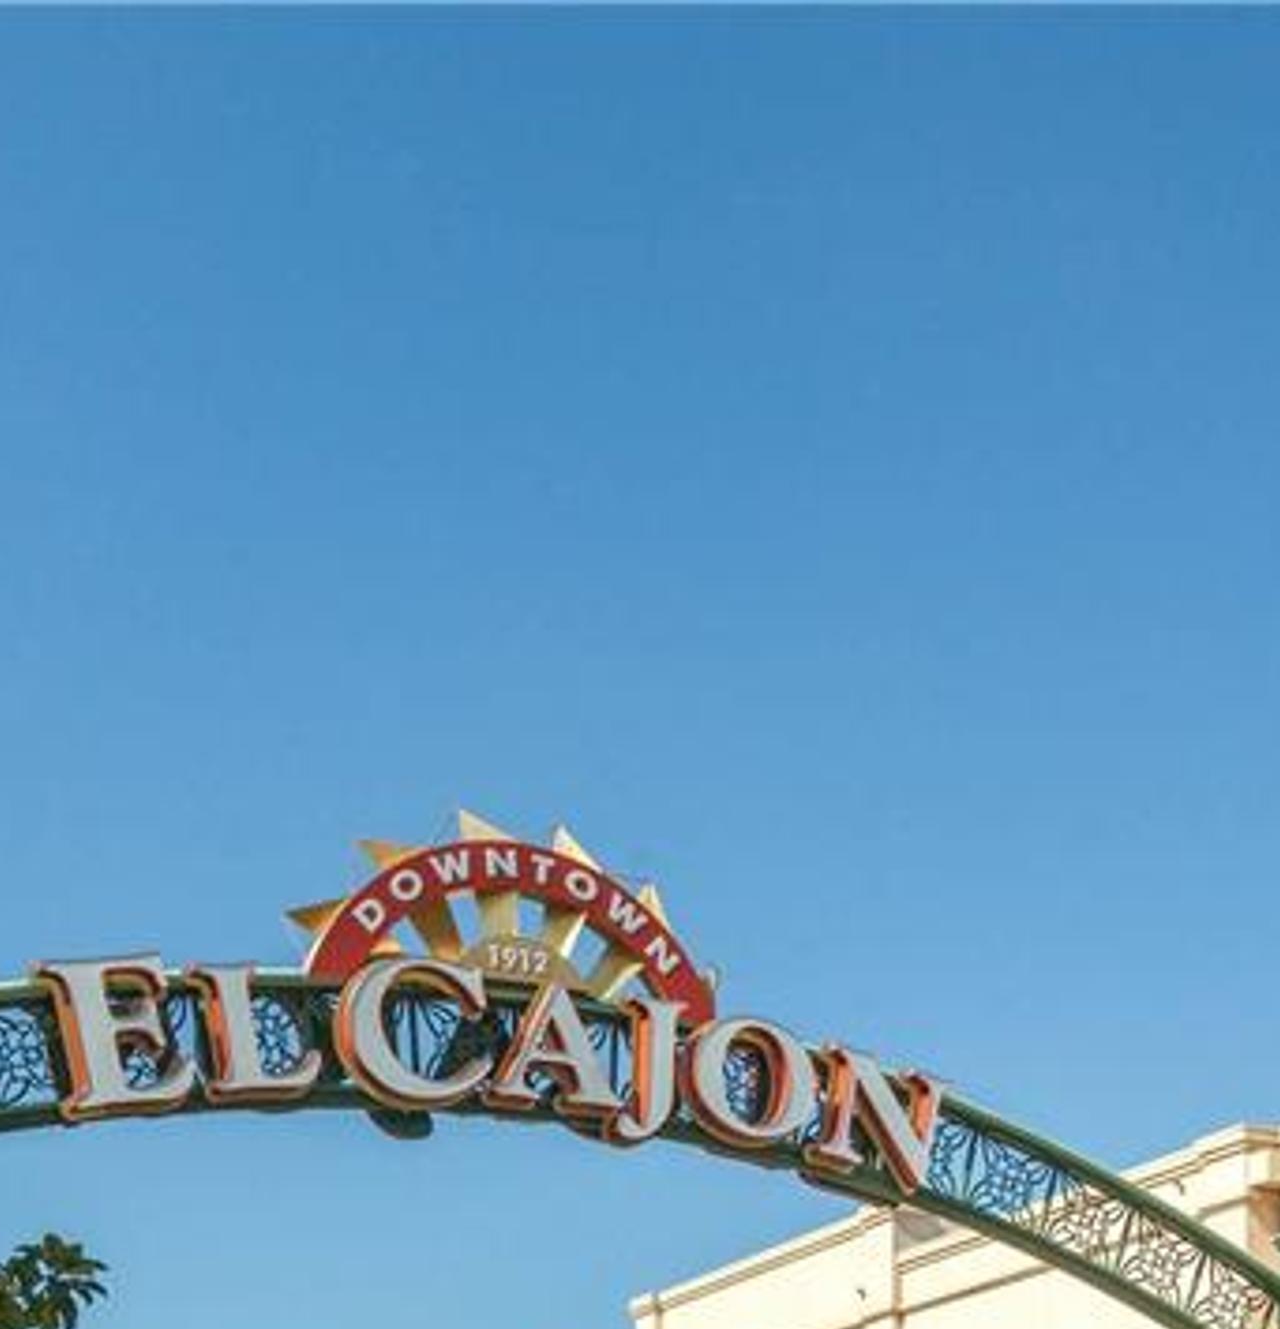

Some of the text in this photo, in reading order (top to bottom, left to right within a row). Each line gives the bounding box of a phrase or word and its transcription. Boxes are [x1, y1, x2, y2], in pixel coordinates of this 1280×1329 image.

[352, 848, 681, 975] DOWNTOWN
[487, 943, 550, 973] 1912
[32, 952, 949, 1195] EL CAJON
